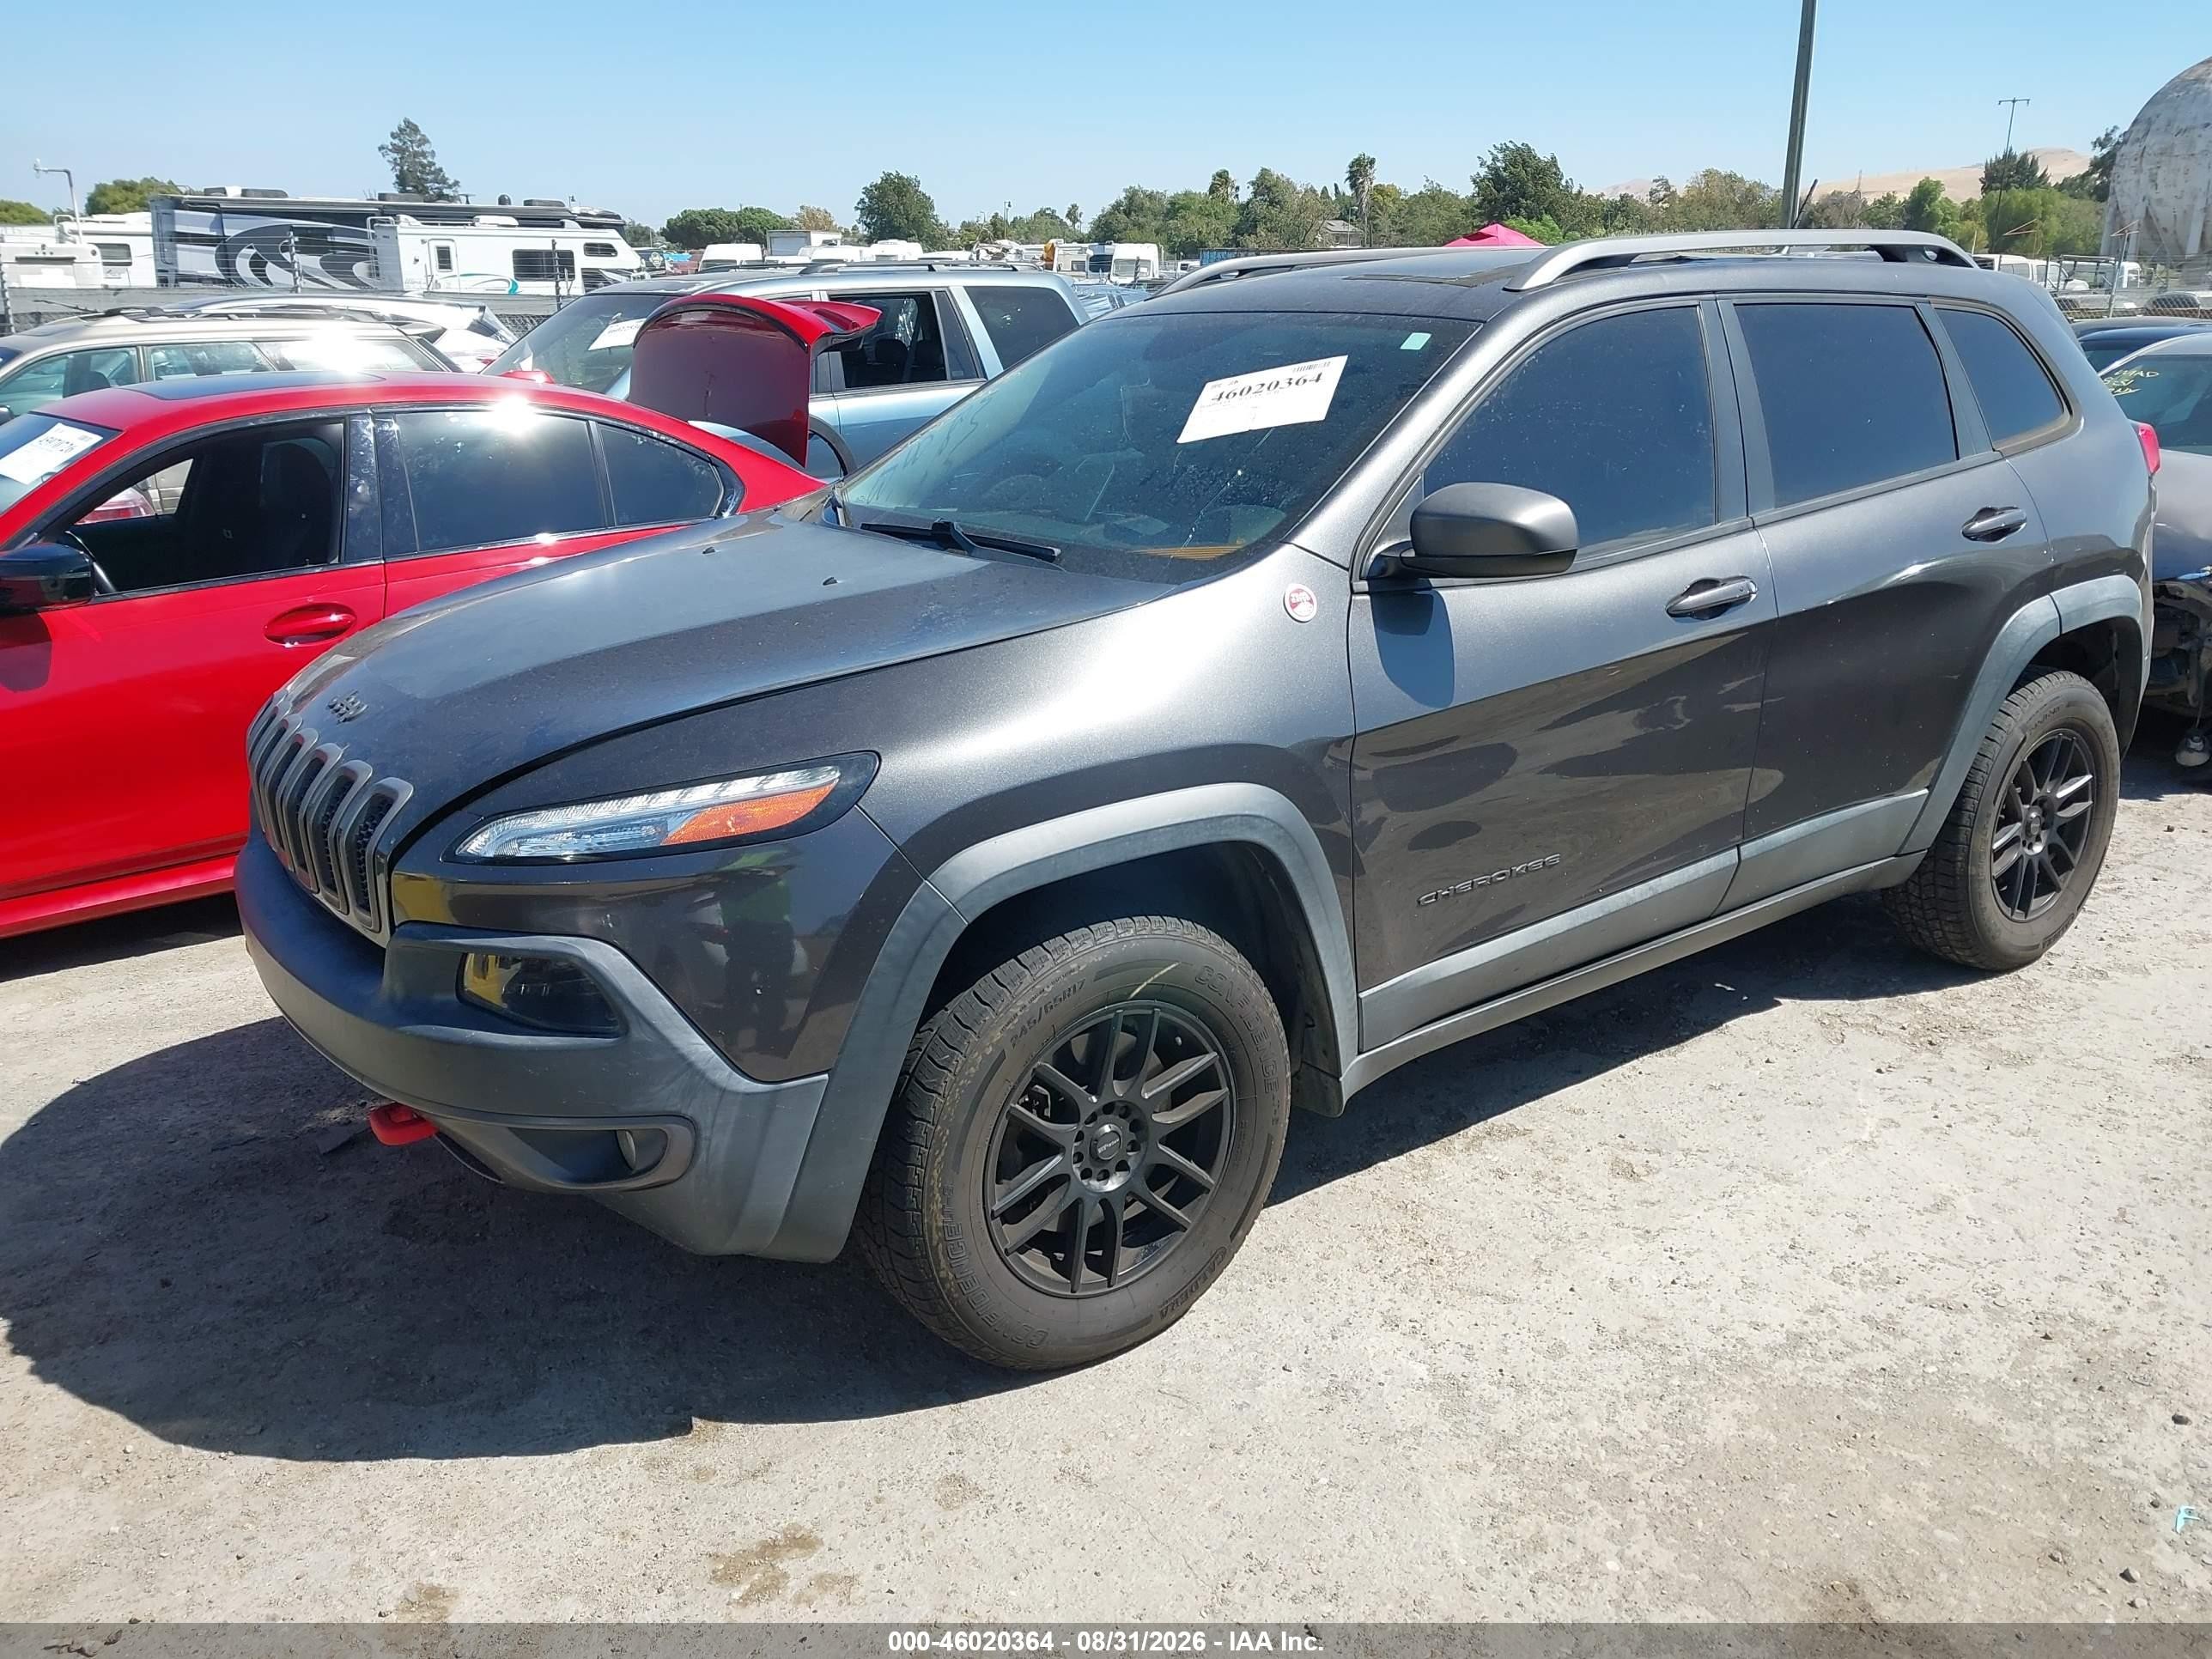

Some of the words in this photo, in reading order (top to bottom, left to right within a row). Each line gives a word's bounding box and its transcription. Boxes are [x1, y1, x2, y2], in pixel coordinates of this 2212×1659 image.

[1211, 371, 1323, 403] 46020364
[1418, 854, 1560, 906] CHEROKEE
[1195, 965, 1279, 1094] CONFIDENCE
[945, 1221, 1048, 1348] CONFIDENCE
[1159, 1247, 1225, 1320] CALDERA
